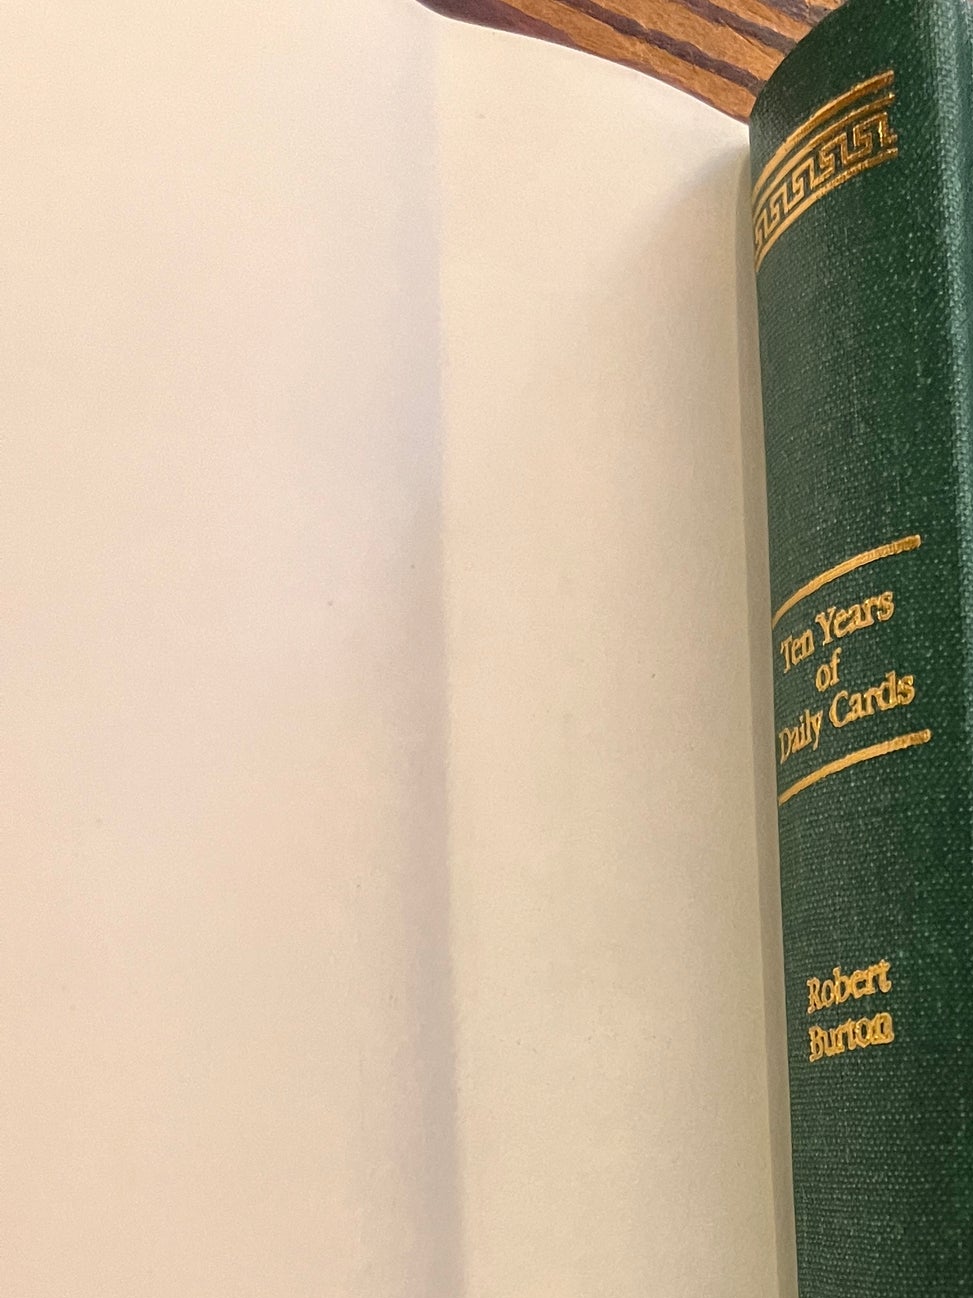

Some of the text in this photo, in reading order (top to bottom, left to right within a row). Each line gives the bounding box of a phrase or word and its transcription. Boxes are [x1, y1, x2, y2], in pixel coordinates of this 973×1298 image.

[780, 591, 895, 673] Ten Years
[815, 647, 842, 692] of
[779, 671, 916, 764] Daily Cards
[806, 959, 892, 1014] Robert
[808, 1012, 895, 1062] Burton
